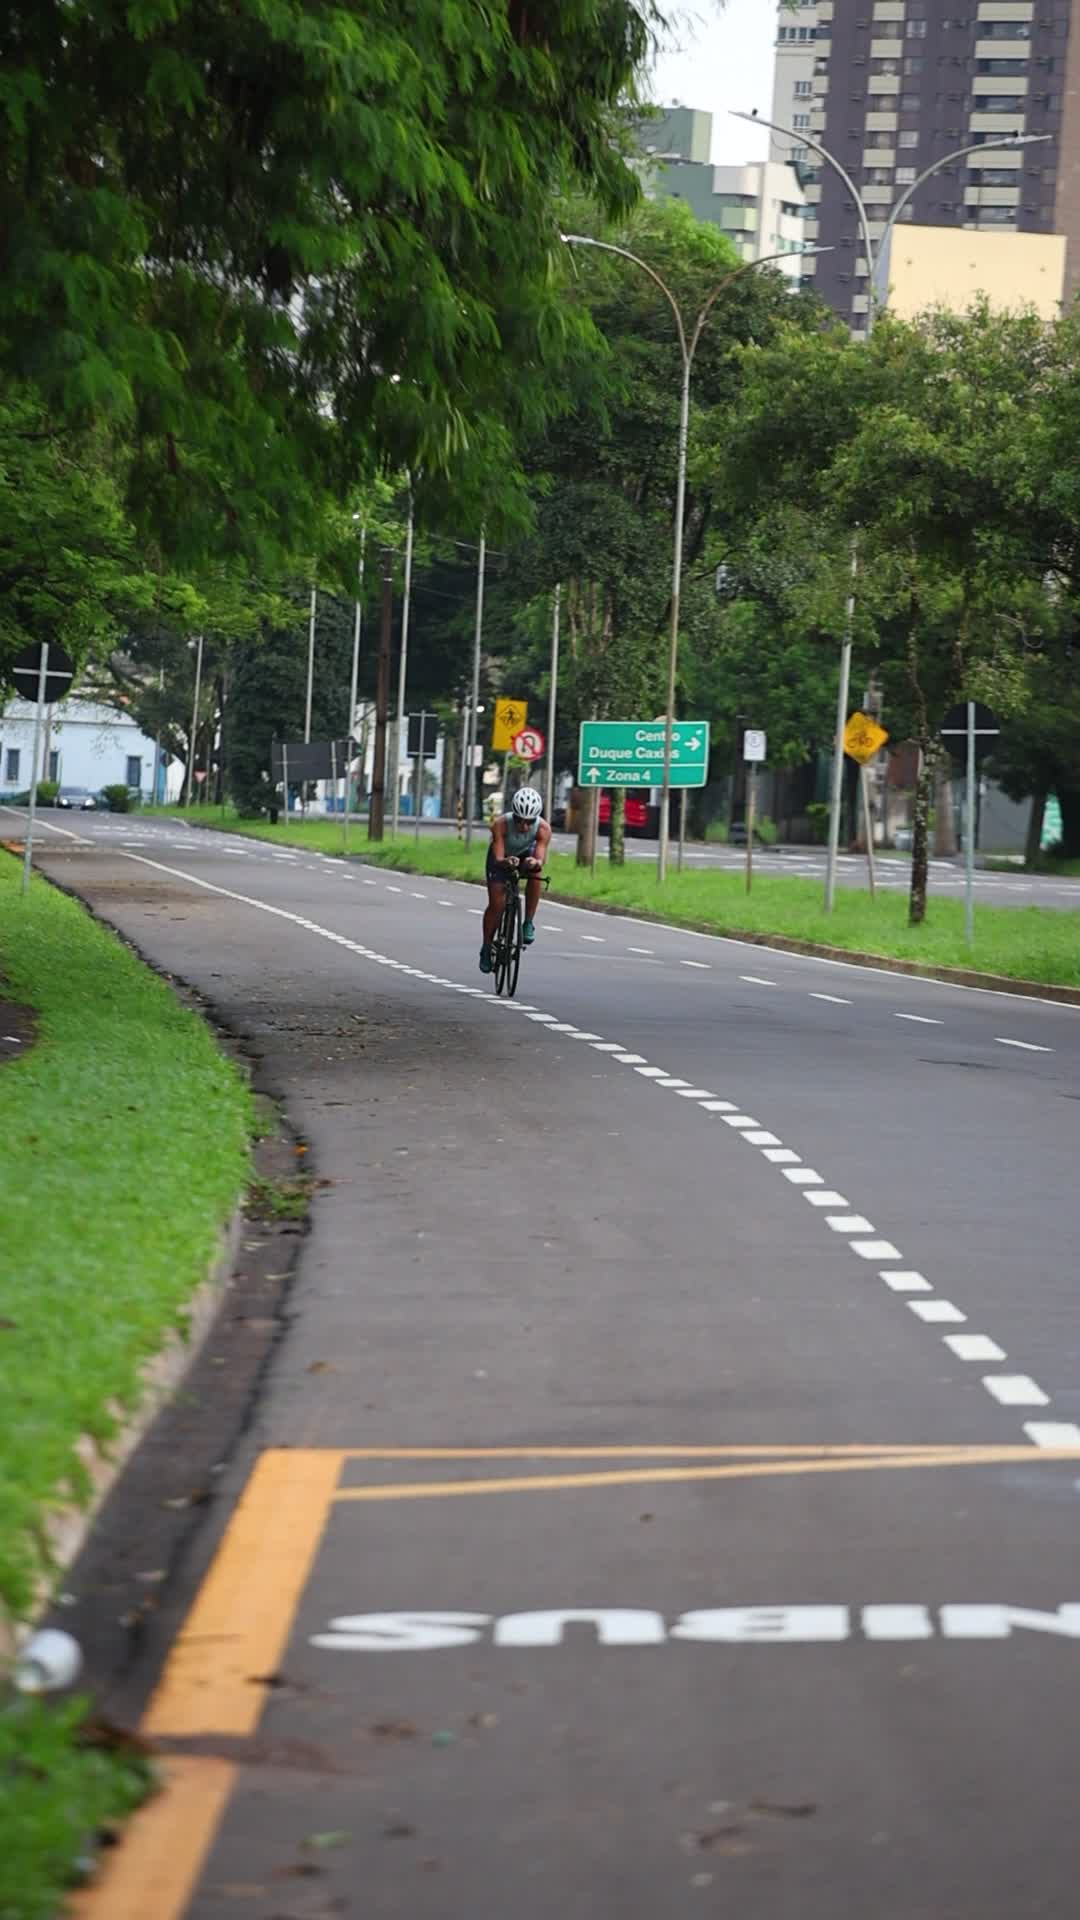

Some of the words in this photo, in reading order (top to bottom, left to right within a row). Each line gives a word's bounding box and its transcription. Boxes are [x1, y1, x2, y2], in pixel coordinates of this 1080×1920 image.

[635, 730, 681, 742] Cento
[589, 747, 632, 761] Duque
[606, 770, 640, 781] Zona
[641, 770, 651, 781] 4
